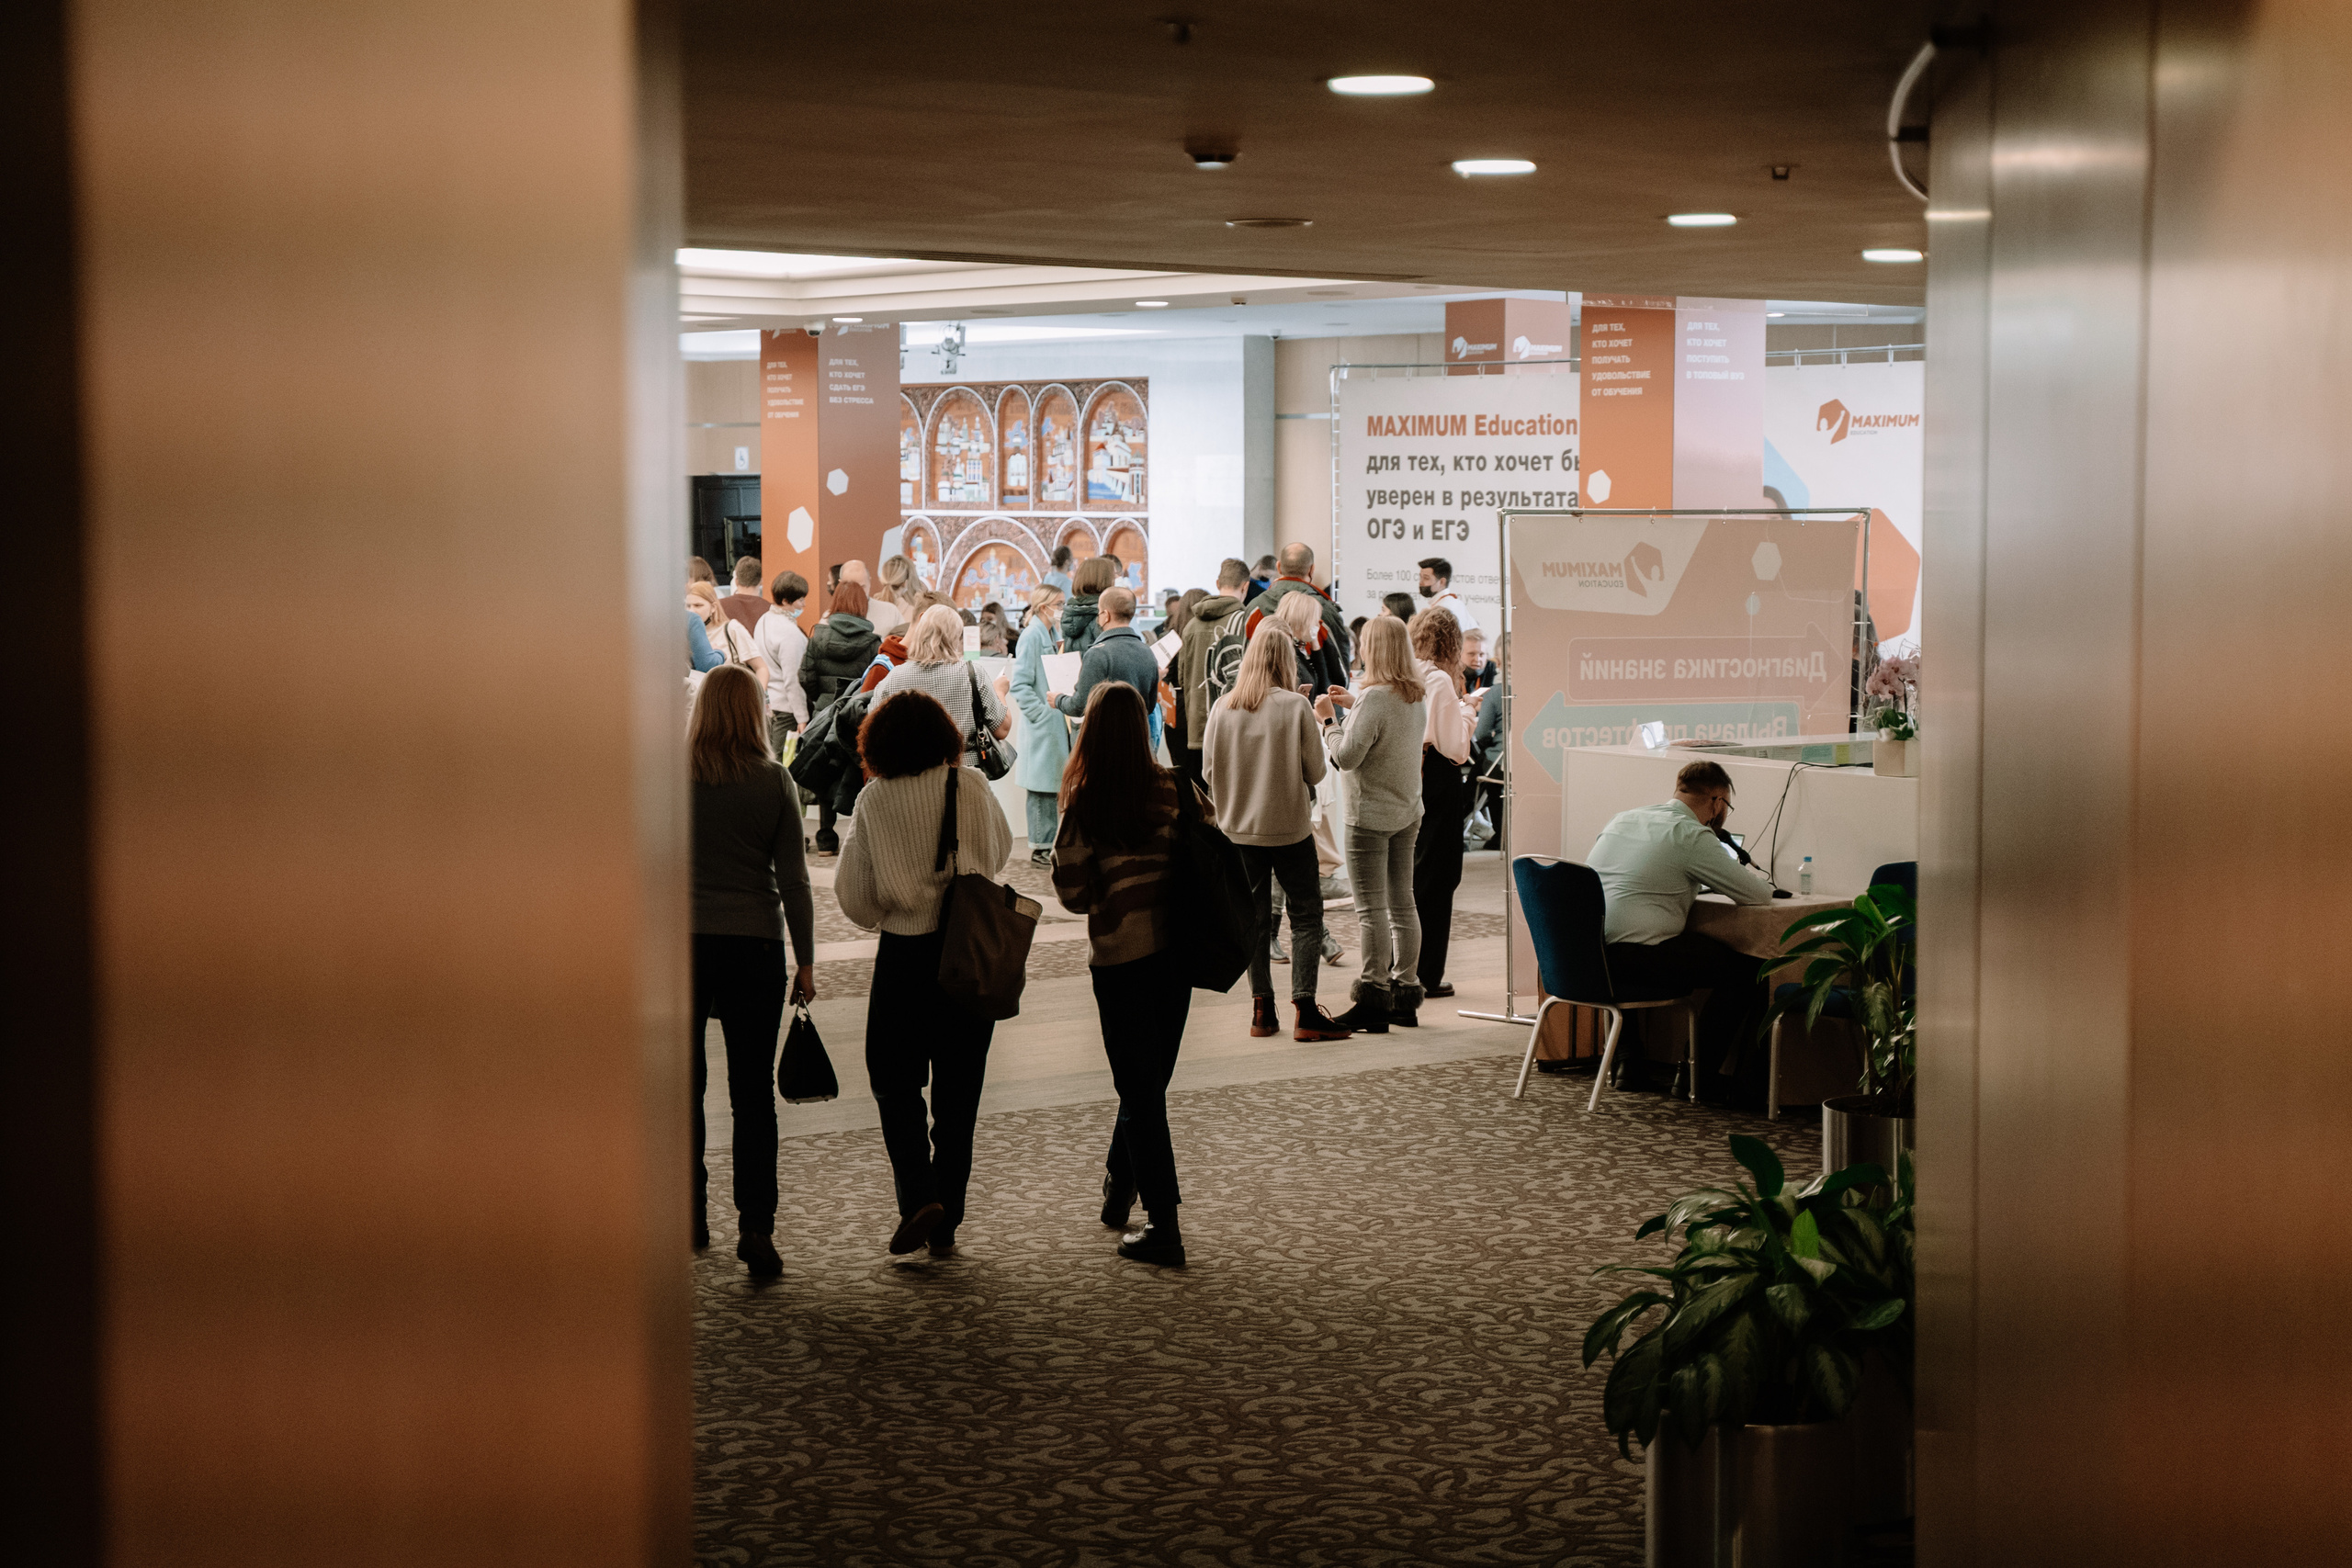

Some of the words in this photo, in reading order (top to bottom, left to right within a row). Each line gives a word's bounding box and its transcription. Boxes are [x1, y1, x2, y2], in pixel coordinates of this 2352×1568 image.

[1591, 323, 1608, 333] ДЛЯ
[1610, 322, 1625, 333] ТЕХ,
[1592, 339, 1608, 348] КТО
[1608, 338, 1633, 348] ХОЧЕТ
[1591, 355, 1631, 365] ПОЛУЧАТЬ
[1591, 370, 1651, 382] УДОВОЛЬСТВИЕ
[1591, 388, 1602, 397] ОТ
[1602, 387, 1643, 396] ОБУЧЕНИЯ
[1367, 414, 1467, 436] MAXIMUM
[1475, 413, 1578, 436] Education
[1851, 413, 1920, 428] MAXIMUM
[1366, 455, 1400, 474] для
[1408, 455, 1445, 476] тех,
[1453, 455, 1487, 471] кто
[1494, 455, 1554, 471] хочет
[1366, 489, 1434, 509] уверен
[1442, 490, 1453, 506] в
[1367, 517, 1405, 540] ОГЭ
[1413, 524, 1424, 540] и
[1431, 519, 1470, 541] ЕГЭ
[1366, 568, 1394, 581] Более
[1396, 570, 1411, 581] 100
[1366, 589, 1376, 599] за
